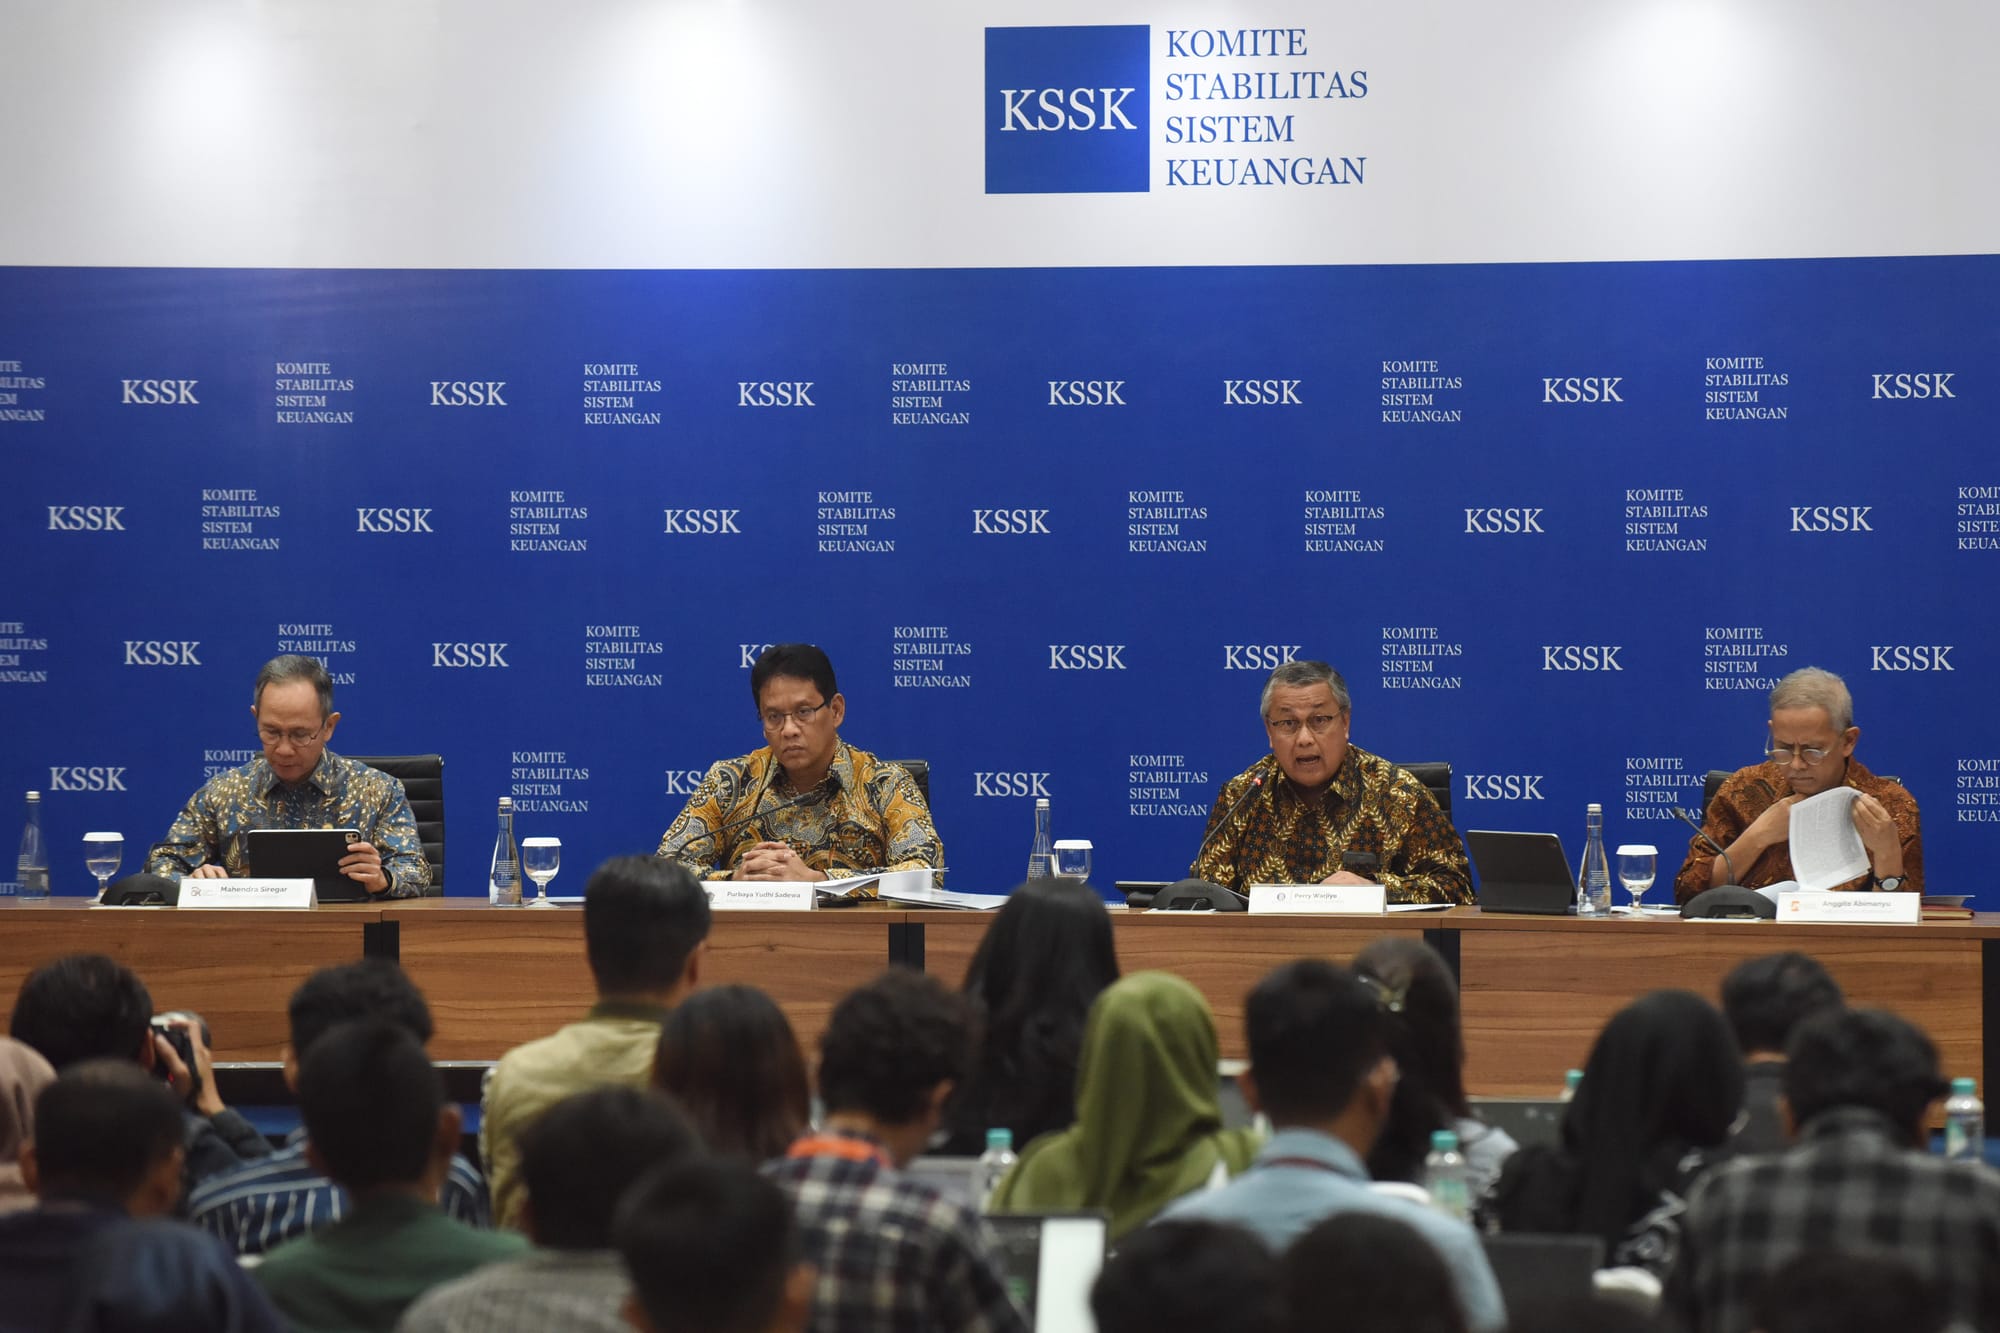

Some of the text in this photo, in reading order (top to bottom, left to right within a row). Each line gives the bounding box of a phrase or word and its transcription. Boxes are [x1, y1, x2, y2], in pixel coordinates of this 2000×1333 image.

[1166, 28, 1308, 58] KOMITE
[1165, 70, 1368, 101] STABILITAS
[1000, 87, 1138, 131] KSSK
[1165, 115, 1295, 144] SISTEM
[1166, 156, 1367, 186] KEUANGAN
[276, 362, 332, 375] KOMITE
[583, 363, 639, 376] KOMITE
[892, 363, 948, 376] KOMITE
[1382, 360, 1439, 373] KOMITE
[1705, 356, 1765, 370] KOMITE
[275, 378, 354, 391] STABILITAS
[583, 379, 662, 392] STABILITAS
[891, 379, 971, 392] STABILITAS
[1381, 376, 1463, 390] STABILITAS
[1704, 373, 1789, 387] STABILITAS
[1871, 372, 1957, 400] KSSK
[121, 379, 200, 405] KSSK
[429, 381, 508, 407] KSSK
[737, 381, 816, 407] KSSK
[1047, 380, 1127, 406] KSSK
[1223, 379, 1303, 405] KSSK
[1542, 376, 1625, 403] KSSK
[275, 395, 326, 407] SISTEM
[583, 396, 634, 409] SISTEM
[891, 396, 943, 409] SISTEM
[1381, 393, 1433, 406] SISTEM
[1704, 390, 1759, 404] SISTEM
[0, 409, 45, 422] ANGAN
[276, 411, 354, 424] KEUANGAN
[584, 412, 661, 425] KEUANGAN
[892, 412, 970, 425] KEUANGAN
[1382, 409, 1462, 423] KEUANGAN
[1705, 407, 1789, 421] KEUANGAN
[202, 488, 257, 502] KOMITE
[510, 490, 565, 503] KOMITE
[817, 491, 873, 504] KOMITE
[1128, 490, 1185, 503] KOMITE
[1305, 490, 1361, 503] KOMITE
[1625, 488, 1684, 502] KOMITE
[1958, 486, 2000, 499] KOMI
[201, 505, 281, 518] STABILITAS
[509, 506, 588, 520] STABILITAS
[817, 507, 896, 520] STABILITAS
[1128, 506, 1208, 520] STABILITAS
[1304, 506, 1385, 520] STABILITAS
[1625, 505, 1709, 519] STABILITAS
[1957, 503, 2000, 516] STABI
[47, 505, 126, 531] KSSK
[356, 507, 434, 533] KSSK
[663, 508, 742, 535] KSSK
[972, 508, 1051, 535] KSSK
[1463, 507, 1545, 534] KSSK
[1789, 505, 1874, 532] KSSK
[201, 521, 253, 534] SISTEM
[509, 523, 560, 536] SISTEM
[817, 523, 868, 536] SISTEM
[1128, 523, 1179, 536] SISTEM
[1304, 523, 1356, 536] SISTEM
[1625, 522, 1678, 535] SISTEM
[1957, 520, 2000, 533] SISTE
[202, 537, 280, 550] KEUANGAN
[510, 539, 588, 552] KEUANGAN
[818, 539, 896, 553] KEUANGAN
[1128, 539, 1207, 553] KEUANGAN
[1305, 539, 1385, 552] KEUANGAN
[1626, 538, 1708, 552] KEUANGAN
[1958, 537, 2000, 550] KEUA
[0, 622, 24, 634] ITE
[278, 623, 334, 636] KOMITE
[585, 625, 641, 638] KOMITE
[893, 626, 949, 639] KOMITE
[1382, 627, 1439, 640] KOMITE
[1705, 627, 1764, 640] KOMITE
[277, 639, 357, 653] STABILITAS
[585, 641, 664, 654] STABILITAS
[893, 642, 972, 655] STABILITAS
[1381, 643, 1463, 656] STABILITAS
[1704, 643, 1788, 657] STABILITAS
[123, 640, 202, 666] KSSK
[431, 642, 510, 668] KSSK
[1048, 644, 1128, 670] KSSK
[1223, 644, 1302, 670] KSSK
[1541, 645, 1624, 672] KSSK
[1870, 645, 1955, 672] KSSK
[585, 657, 636, 670] SISTEM
[893, 658, 944, 672] SISTEM
[1381, 660, 1433, 673] SISTEM
[1704, 660, 1758, 673] SISTEM
[0, 670, 47, 683] ANGAN
[586, 673, 663, 687] KEUANGAN
[894, 675, 971, 688] KEUANGAN
[1382, 676, 1462, 689] KEUANGAN
[1705, 676, 1777, 690] KEUANGA
[512, 751, 567, 764] KOMITE
[1129, 754, 1185, 768] KOMITE
[1625, 757, 1684, 770] KOMITE
[1958, 759, 2000, 772] KOMI
[49, 766, 128, 792] KSSK
[511, 767, 590, 780] STABILITAS
[1128, 771, 1209, 784] STABILITAS
[973, 771, 1052, 798] KSSK
[1625, 774, 1708, 787] STABILITAS
[1957, 775, 2000, 789] STABI
[511, 783, 561, 796] SISTEM
[1129, 787, 1180, 800] SISTEM
[1464, 774, 1545, 801] KSSK
[1625, 790, 1679, 804] SISTEM
[1957, 792, 2000, 805] SISTE
[512, 799, 589, 812] KEUANGAN
[1129, 803, 1208, 817] KEUANGAN
[1626, 806, 1704, 820] KEUANAN
[1958, 809, 2000, 822] KEUA
[220, 885, 259, 894] Mahendra
[260, 886, 288, 894] Siregar
